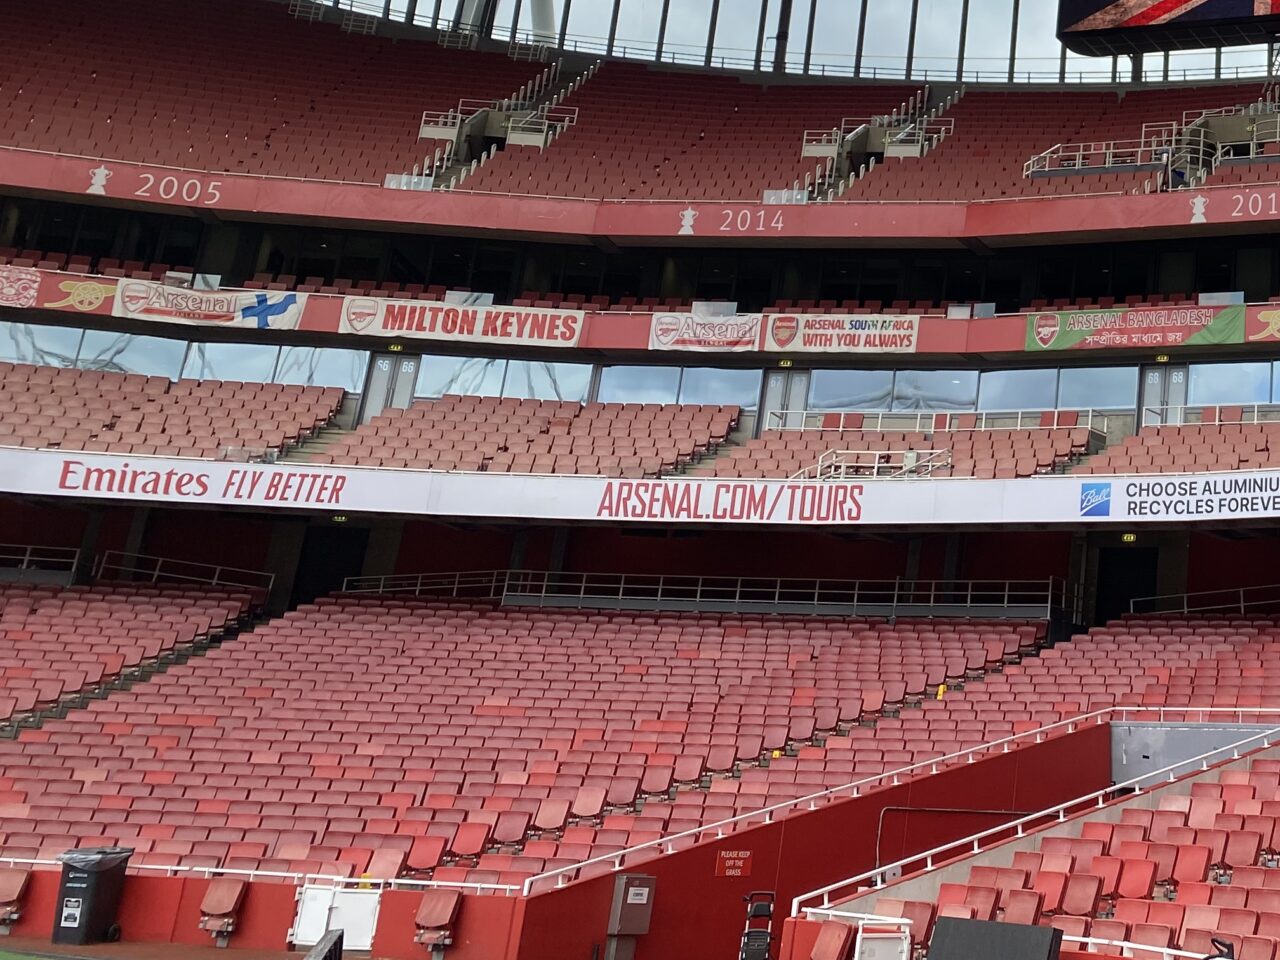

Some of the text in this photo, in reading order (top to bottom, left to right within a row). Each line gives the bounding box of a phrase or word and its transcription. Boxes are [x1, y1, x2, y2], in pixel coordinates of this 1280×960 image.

[134, 173, 222, 204] 2005
[720, 210, 784, 231] 2014
[147, 285, 238, 313] Arsenal
[381, 304, 578, 342] MILTON KEYNES
[680, 316, 759, 339] Arsenal
[803, 319, 914, 331] ARSENAL SOUTH AFRICA
[1066, 309, 1214, 331] ARSENAL BANGLADESH
[802, 333, 913, 348] WITH YOU ALWAYS
[1148, 372, 1159, 384] 68
[1172, 371, 1184, 383] 68
[58, 460, 348, 504] Emirates FLY BETTER
[1126, 481, 1198, 498] CHOOSE
[597, 481, 864, 522] ARSENAL.COM/TOURS
[1081, 487, 1111, 507] Ball
[1127, 498, 1215, 516] RECYCLES
